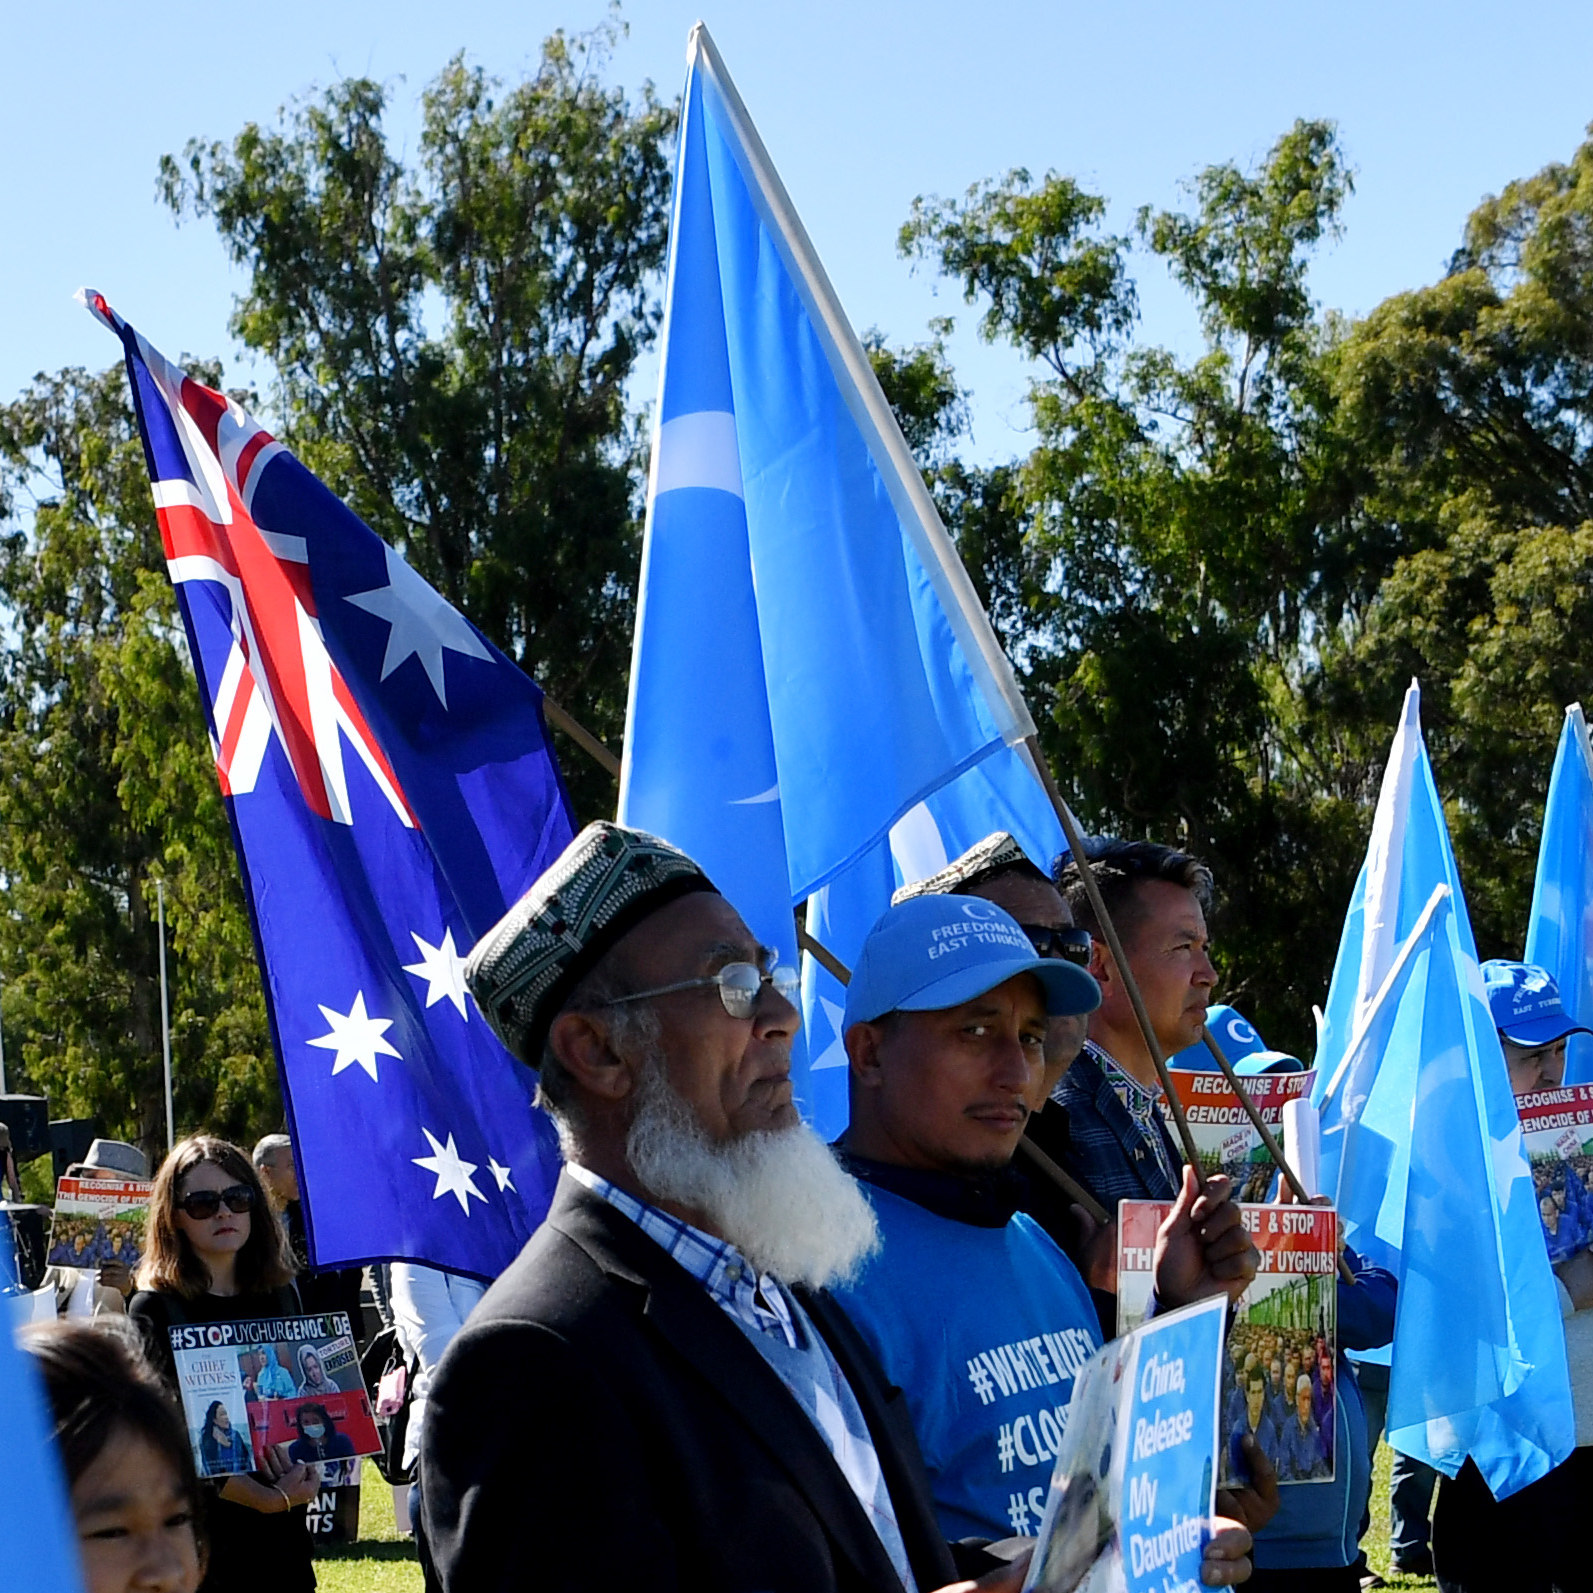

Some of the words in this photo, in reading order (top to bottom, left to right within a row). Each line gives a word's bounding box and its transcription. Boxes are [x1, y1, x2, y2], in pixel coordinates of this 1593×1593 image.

[932, 922, 1009, 942] FREEDOM
[928, 936, 968, 960] EAST
[1191, 1076, 1273, 1095] RECONISE
[1276, 1076, 1287, 1095] &
[1515, 1089, 1576, 1110] ECOGNISE
[1579, 1088, 1589, 1101] &
[1262, 1107, 1277, 1124] OF
[1577, 1111, 1591, 1124] OF
[1268, 1211, 1279, 1234] &
[1282, 1211, 1315, 1235] STOP
[1277, 1251, 1335, 1274] UYGHURS
[318, 1336, 351, 1357] TORTURE
[191, 1358, 226, 1374] CHIEF
[324, 1349, 355, 1373] EXPOSED
[184, 1370, 237, 1387] WITNESS
[1140, 1351, 1186, 1404] China,
[1133, 1409, 1194, 1463] Release
[1129, 1472, 1159, 1527] My
